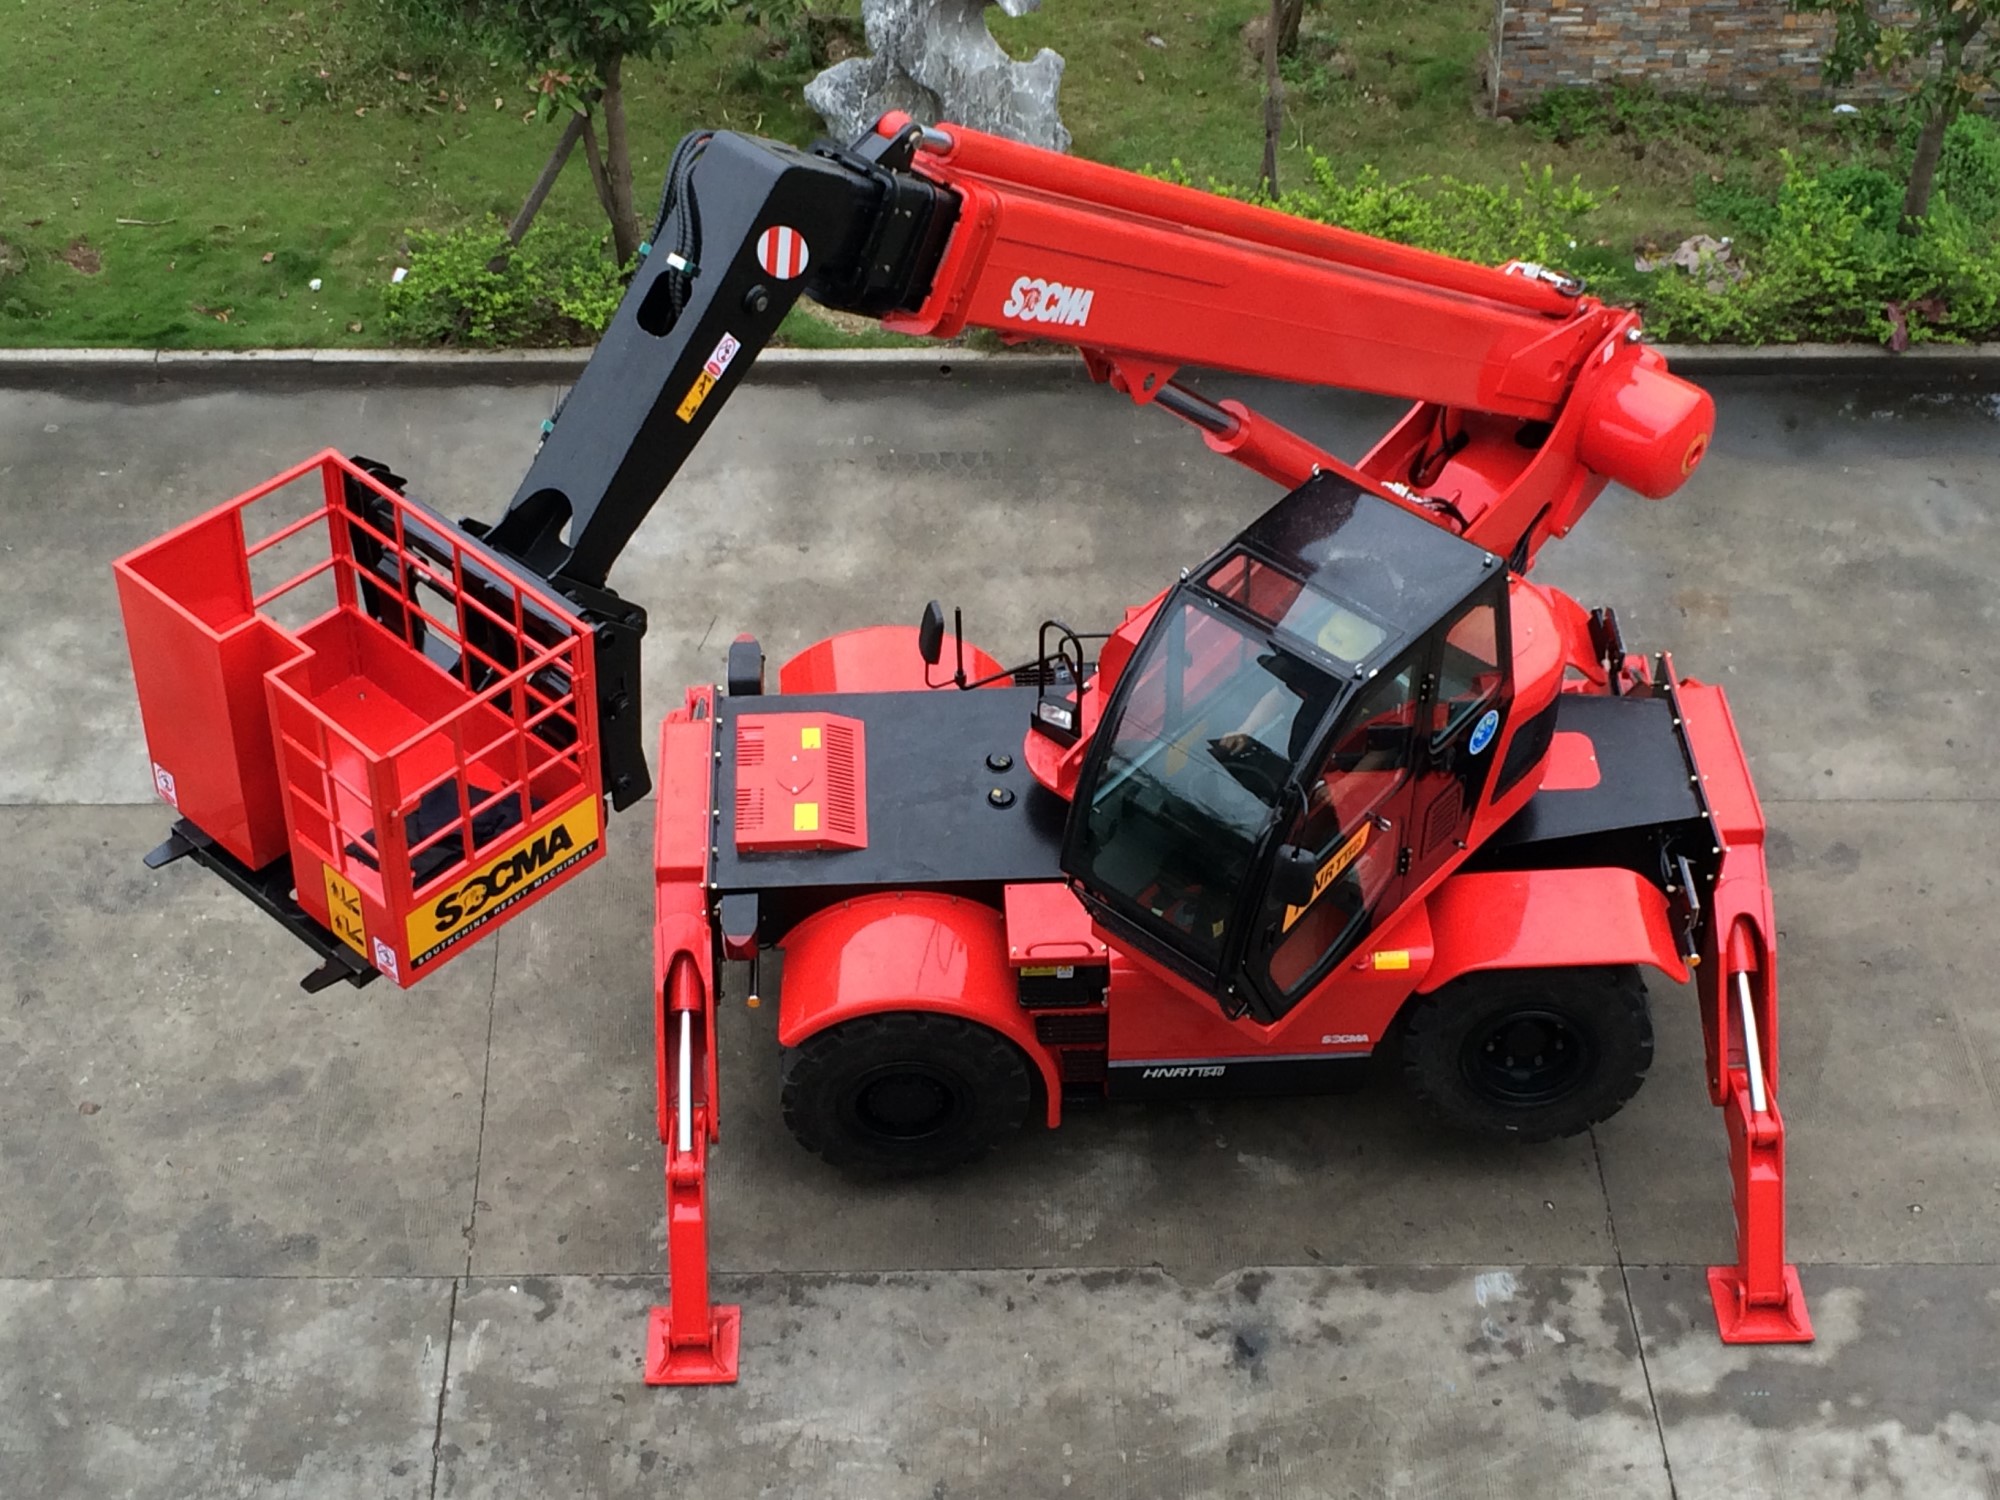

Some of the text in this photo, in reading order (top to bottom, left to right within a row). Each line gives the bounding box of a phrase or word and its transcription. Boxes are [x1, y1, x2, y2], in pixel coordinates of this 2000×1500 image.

[1003, 276, 1094, 327] SOCMA
[417, 844, 594, 966] SOUTHCHINA HEAVY MACHINERY
[435, 823, 574, 932] SOCMA
[1321, 1034, 1370, 1044] SOCMA
